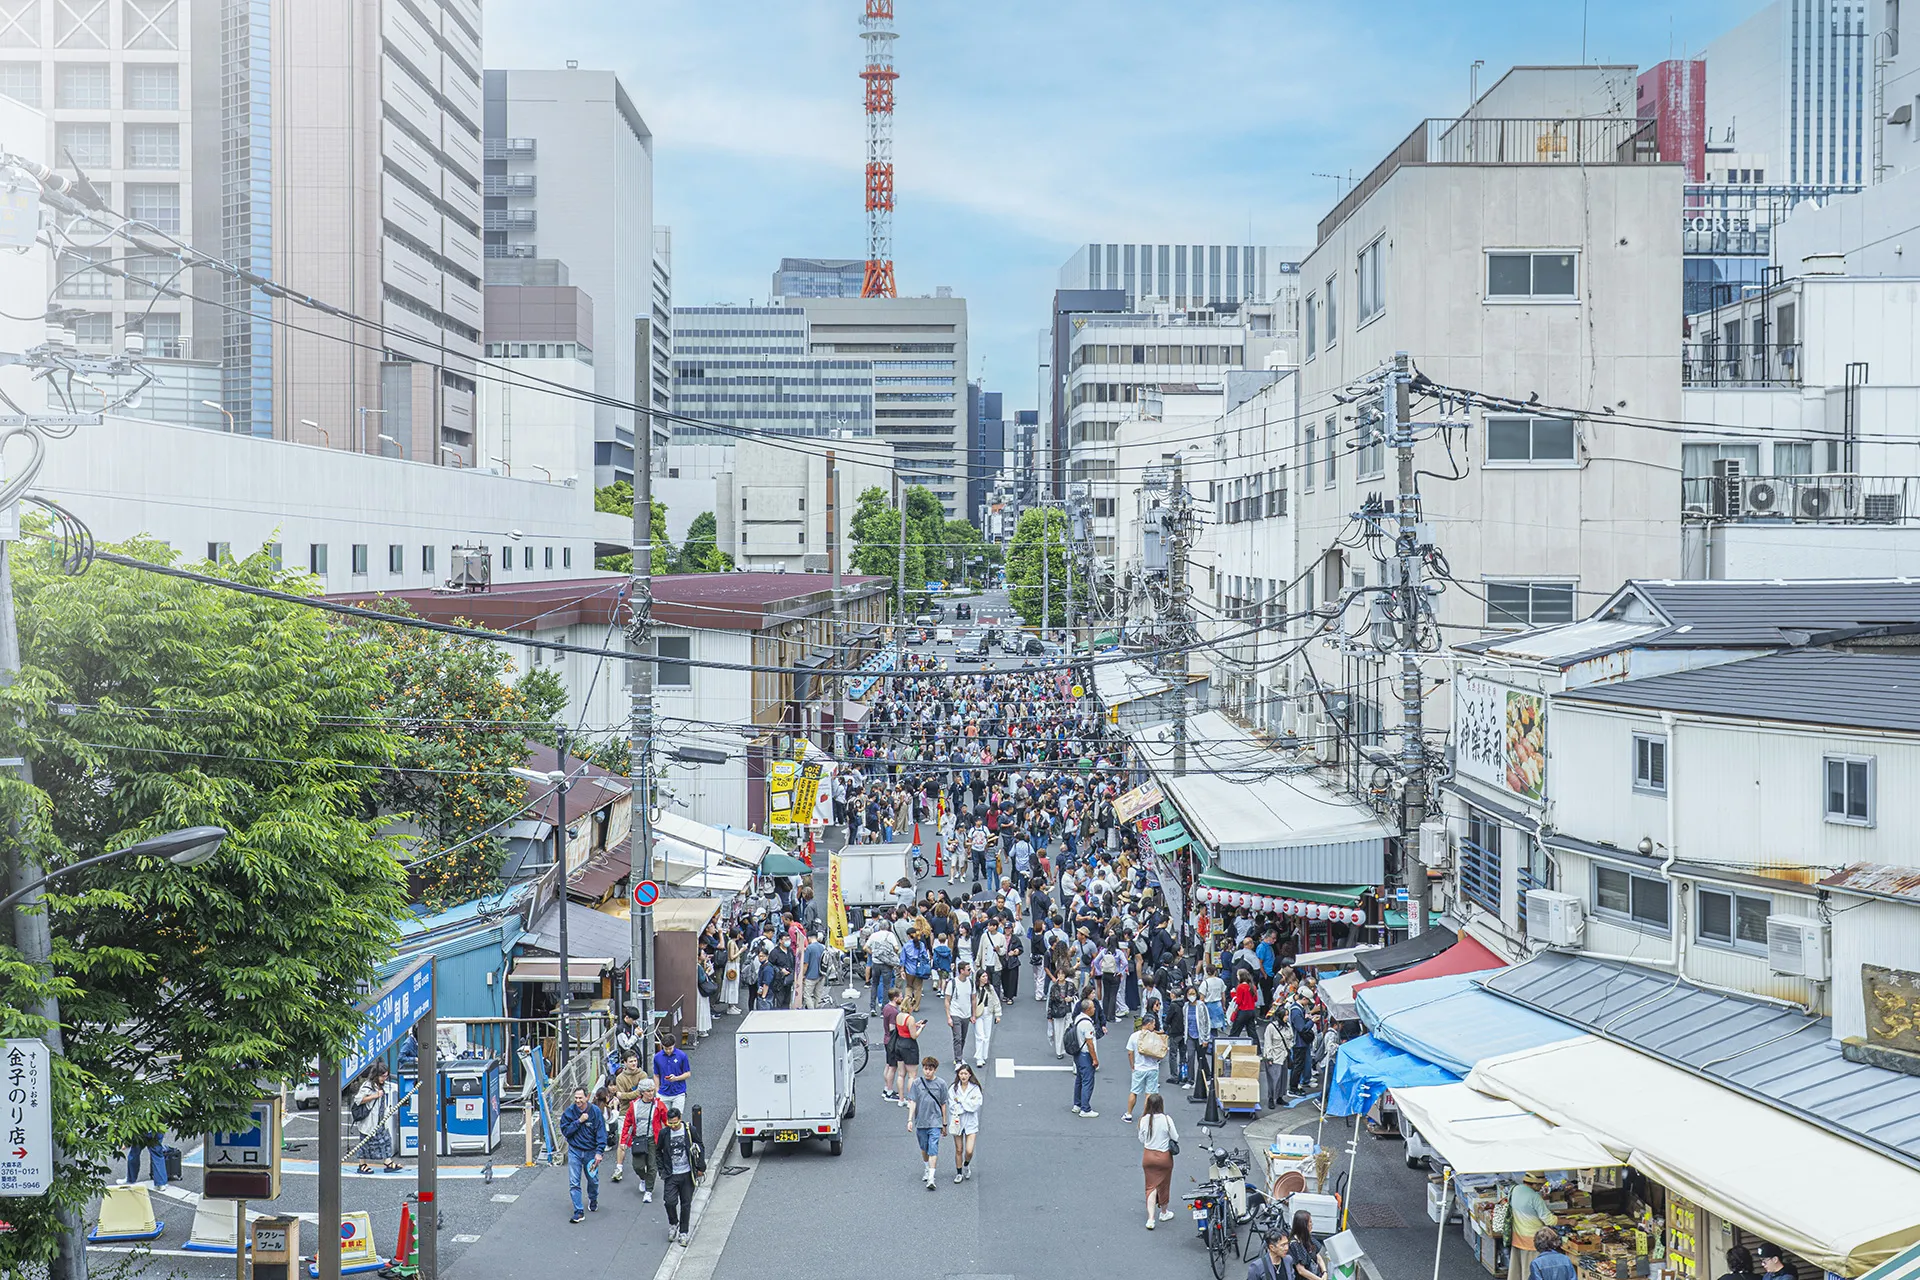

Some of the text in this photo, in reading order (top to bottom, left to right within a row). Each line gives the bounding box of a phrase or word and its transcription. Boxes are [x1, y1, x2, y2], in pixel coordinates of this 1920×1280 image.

[7, 1046, 27, 1146] 金子のり店
[217, 1150, 258, 1163] 入口
[1, 1168, 39, 1176] 3761-0121
[1, 1182, 41, 1190] 3541-5946
[257, 1231, 286, 1240] タクシー
